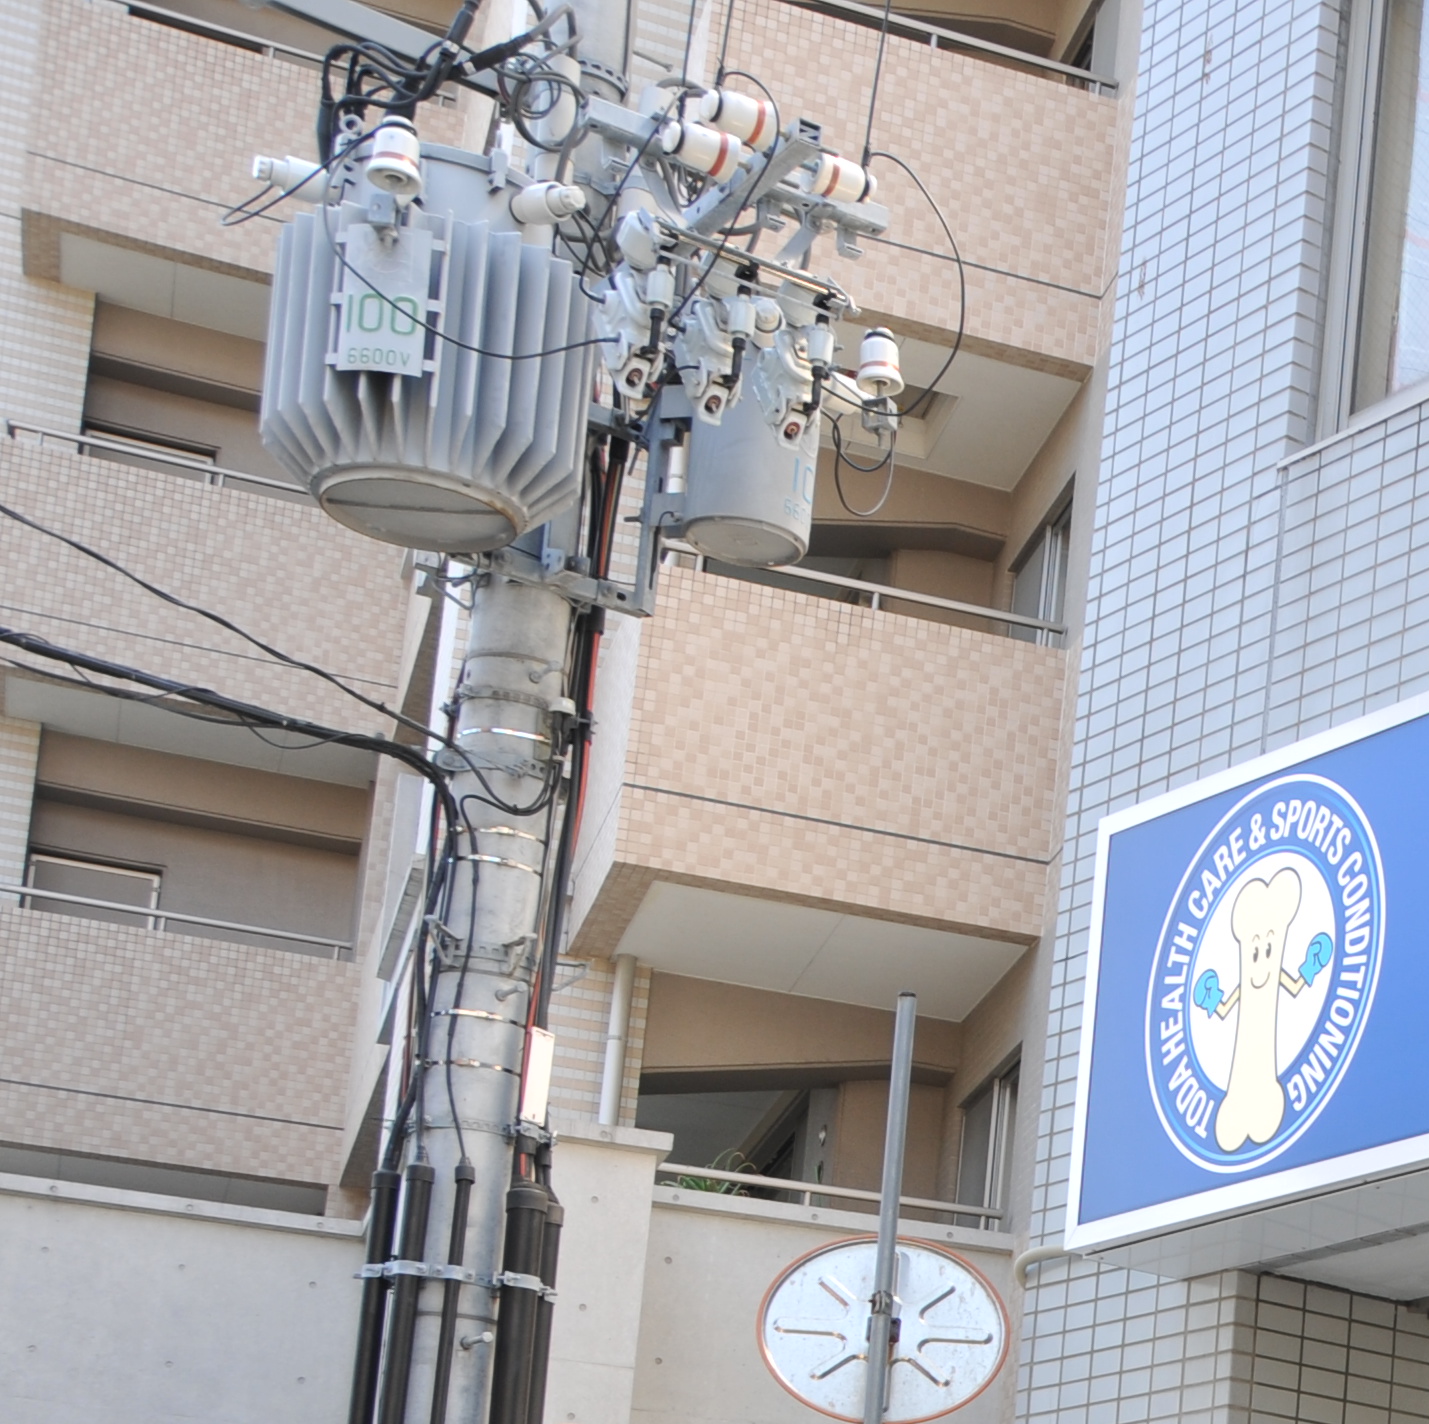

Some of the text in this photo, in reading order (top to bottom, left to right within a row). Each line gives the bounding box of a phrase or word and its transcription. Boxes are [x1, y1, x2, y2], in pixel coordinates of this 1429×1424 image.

[346, 292, 419, 336] 100
[347, 347, 411, 367] 6600V
[1160, 799, 1371, 1138] TODA HEALTH CARE & SPORTS CONDITIONING
